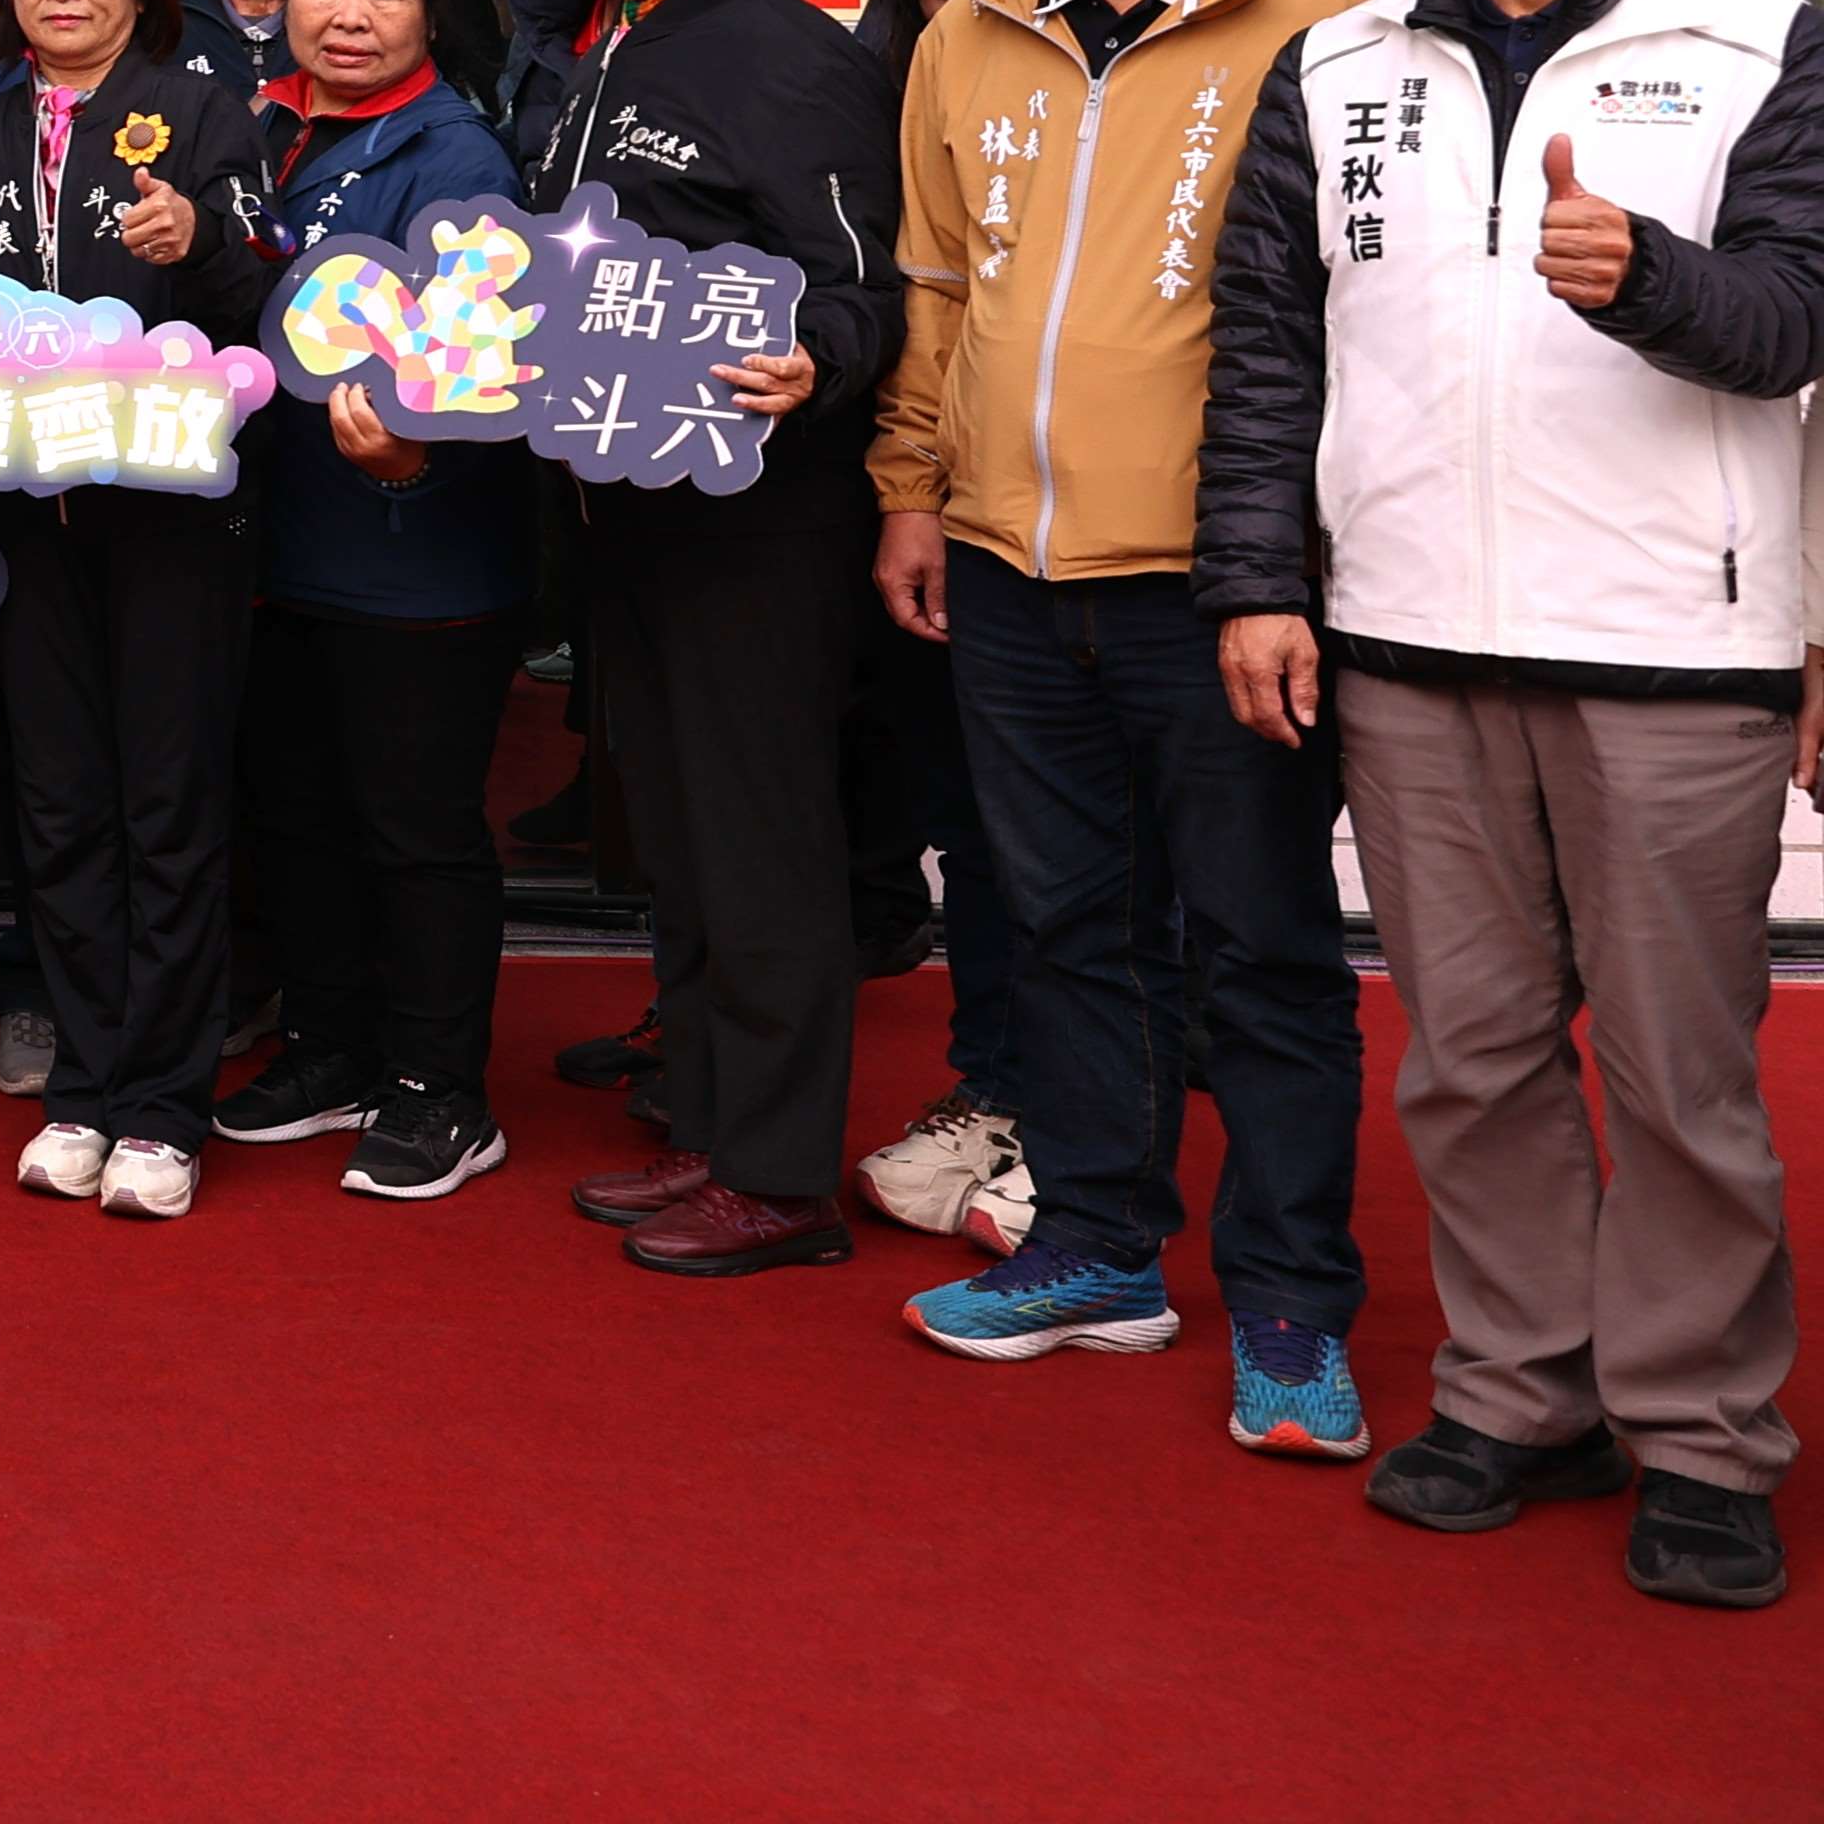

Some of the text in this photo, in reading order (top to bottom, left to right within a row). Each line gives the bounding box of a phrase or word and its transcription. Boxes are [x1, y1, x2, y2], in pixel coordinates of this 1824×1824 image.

[1022, 89, 1049, 161] 代表
[1396, 77, 1429, 154] 理事長
[1620, 80, 1683, 97] 雲林縣
[1151, 86, 1225, 300] 斗六市民代表會
[1341, 101, 1389, 263] 王秋信
[578, 257, 776, 350] 點亮
[554, 373, 744, 468] 斗六
